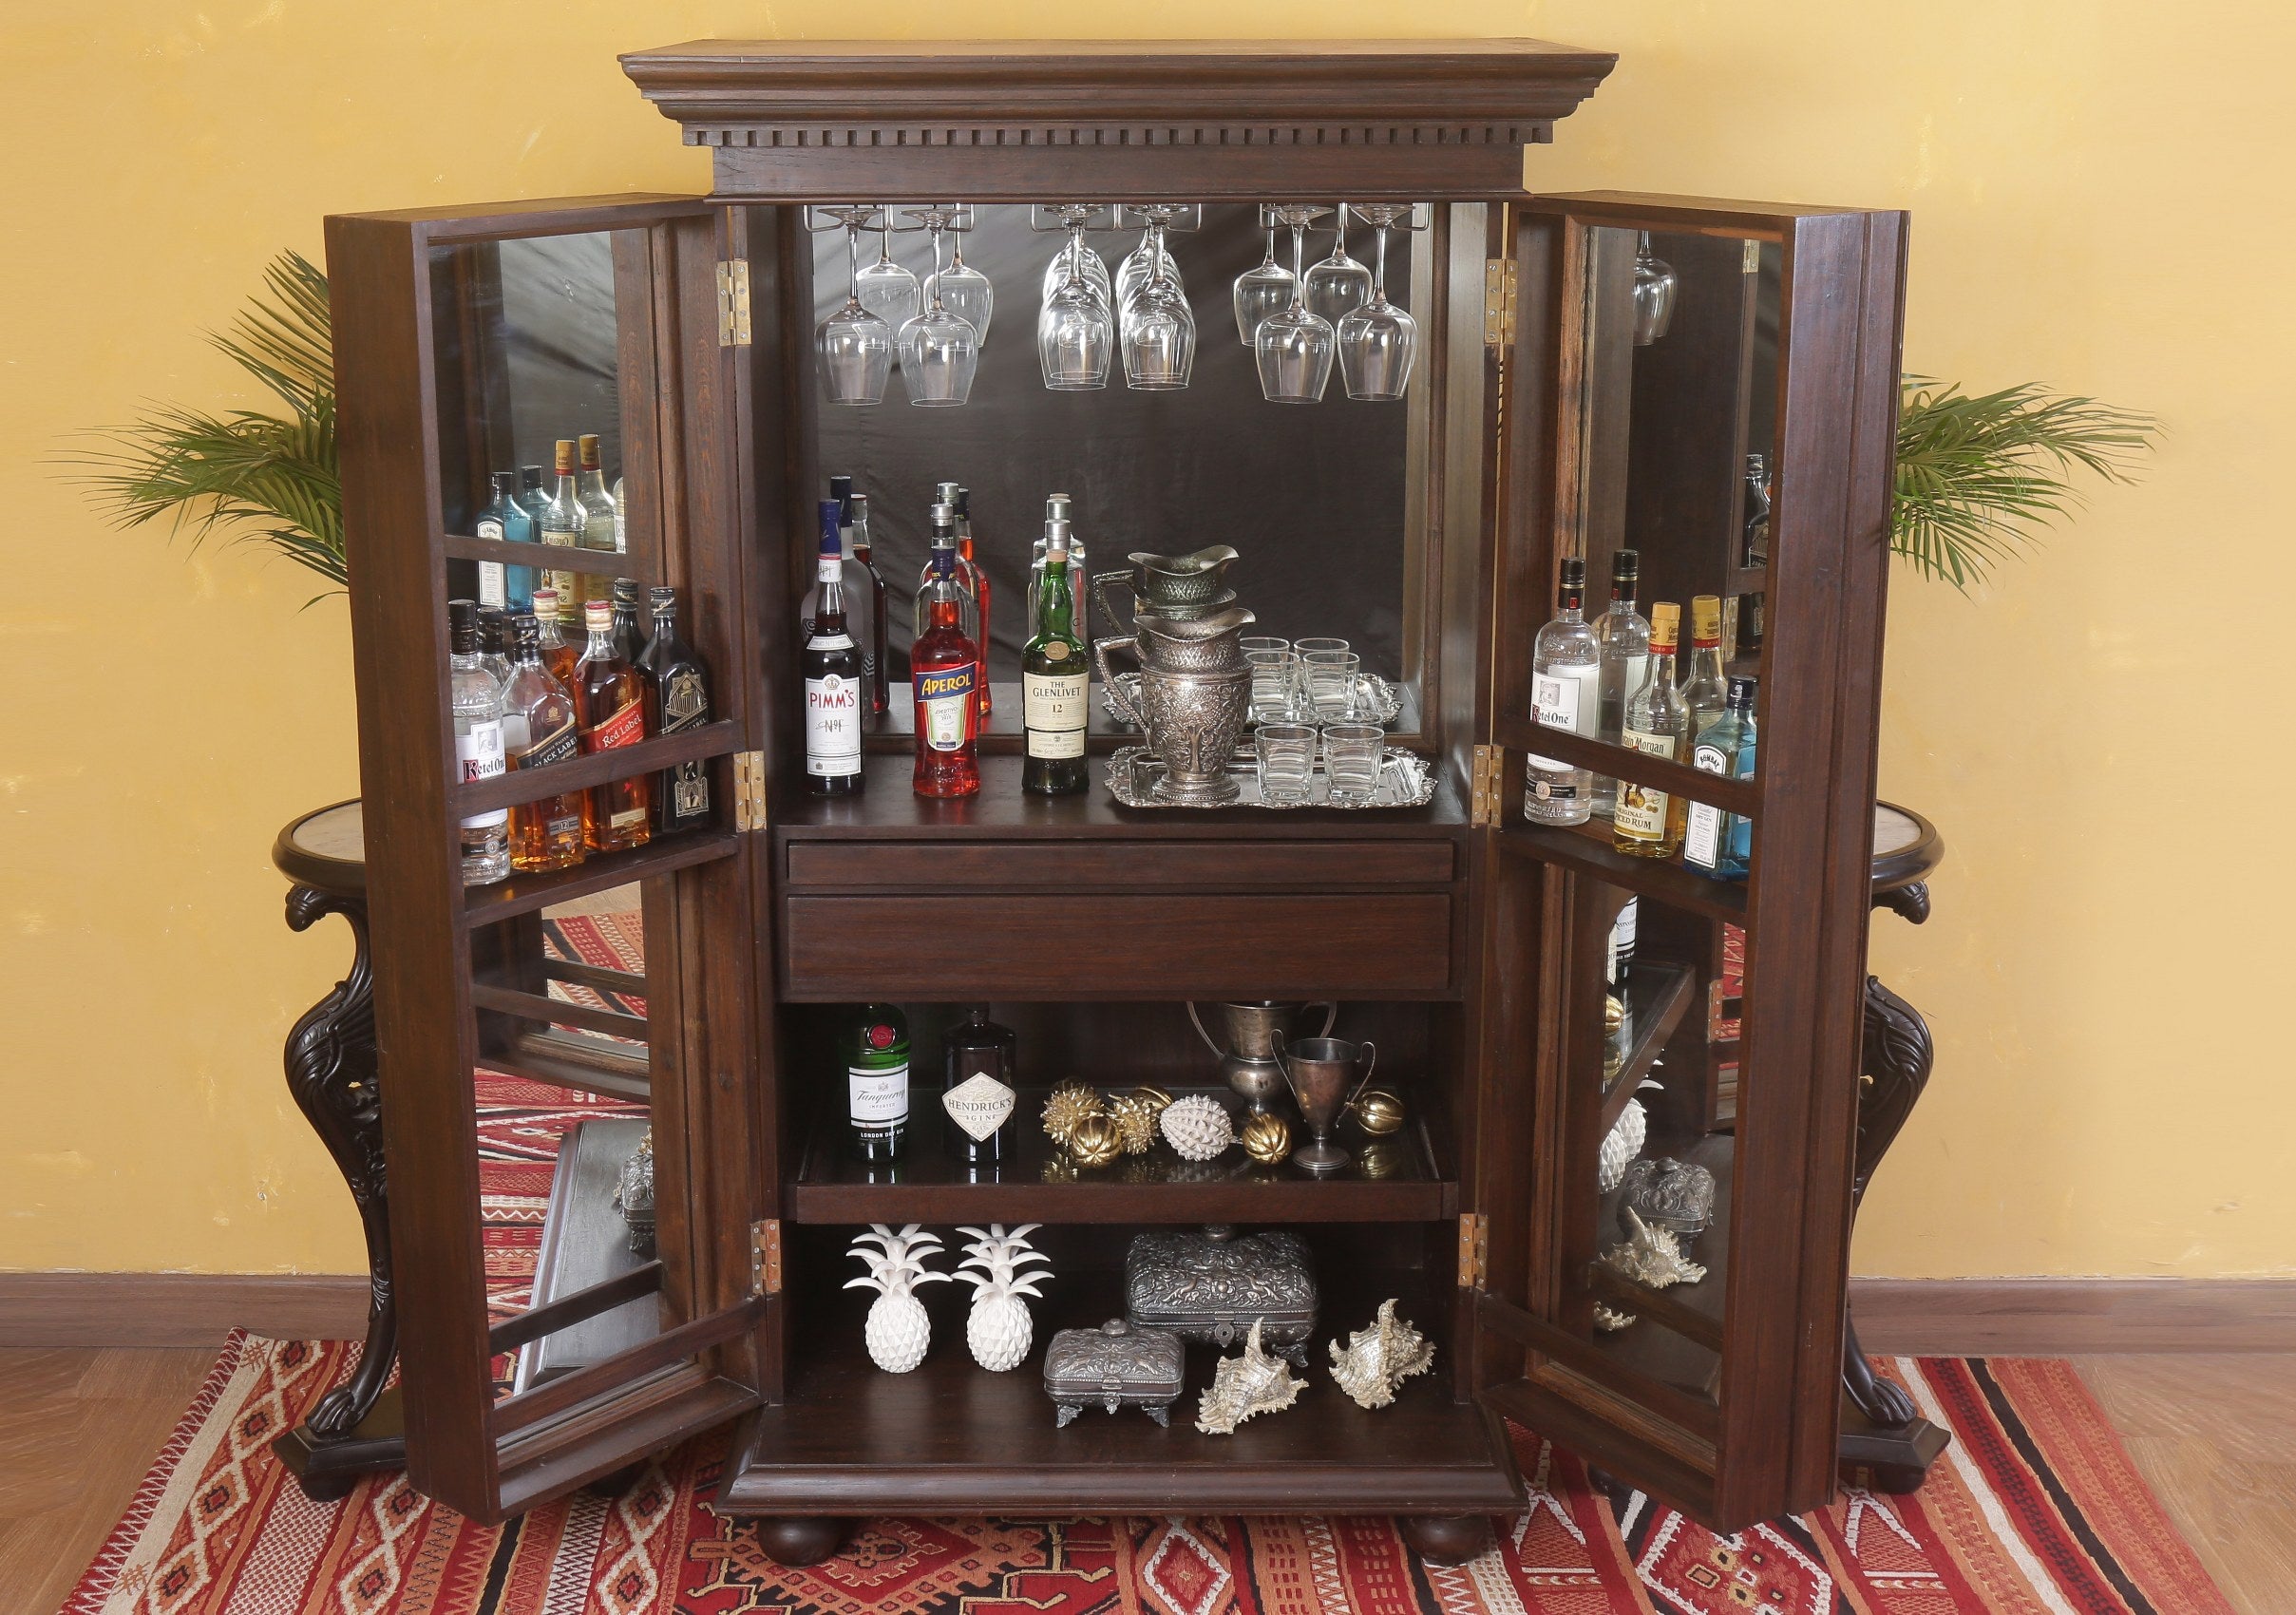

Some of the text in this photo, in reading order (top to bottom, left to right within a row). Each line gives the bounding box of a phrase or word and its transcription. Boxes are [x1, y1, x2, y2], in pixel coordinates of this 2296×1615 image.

[921, 674, 972, 696] APEROL
[1033, 687, 1081, 697] GLENLIVET
[809, 689, 855, 709] PIMM'S
[1052, 704, 1063, 712] 12
[1531, 704, 1569, 724] Ketel One
[601, 713, 642, 748] Red Label
[1635, 736, 1664, 755] Morgan
[464, 759, 493, 781] Ketel
[560, 821, 568, 830] 12
[1632, 818, 1652, 830] RUM
[948, 1096, 1012, 1112] HENDRICK'S
